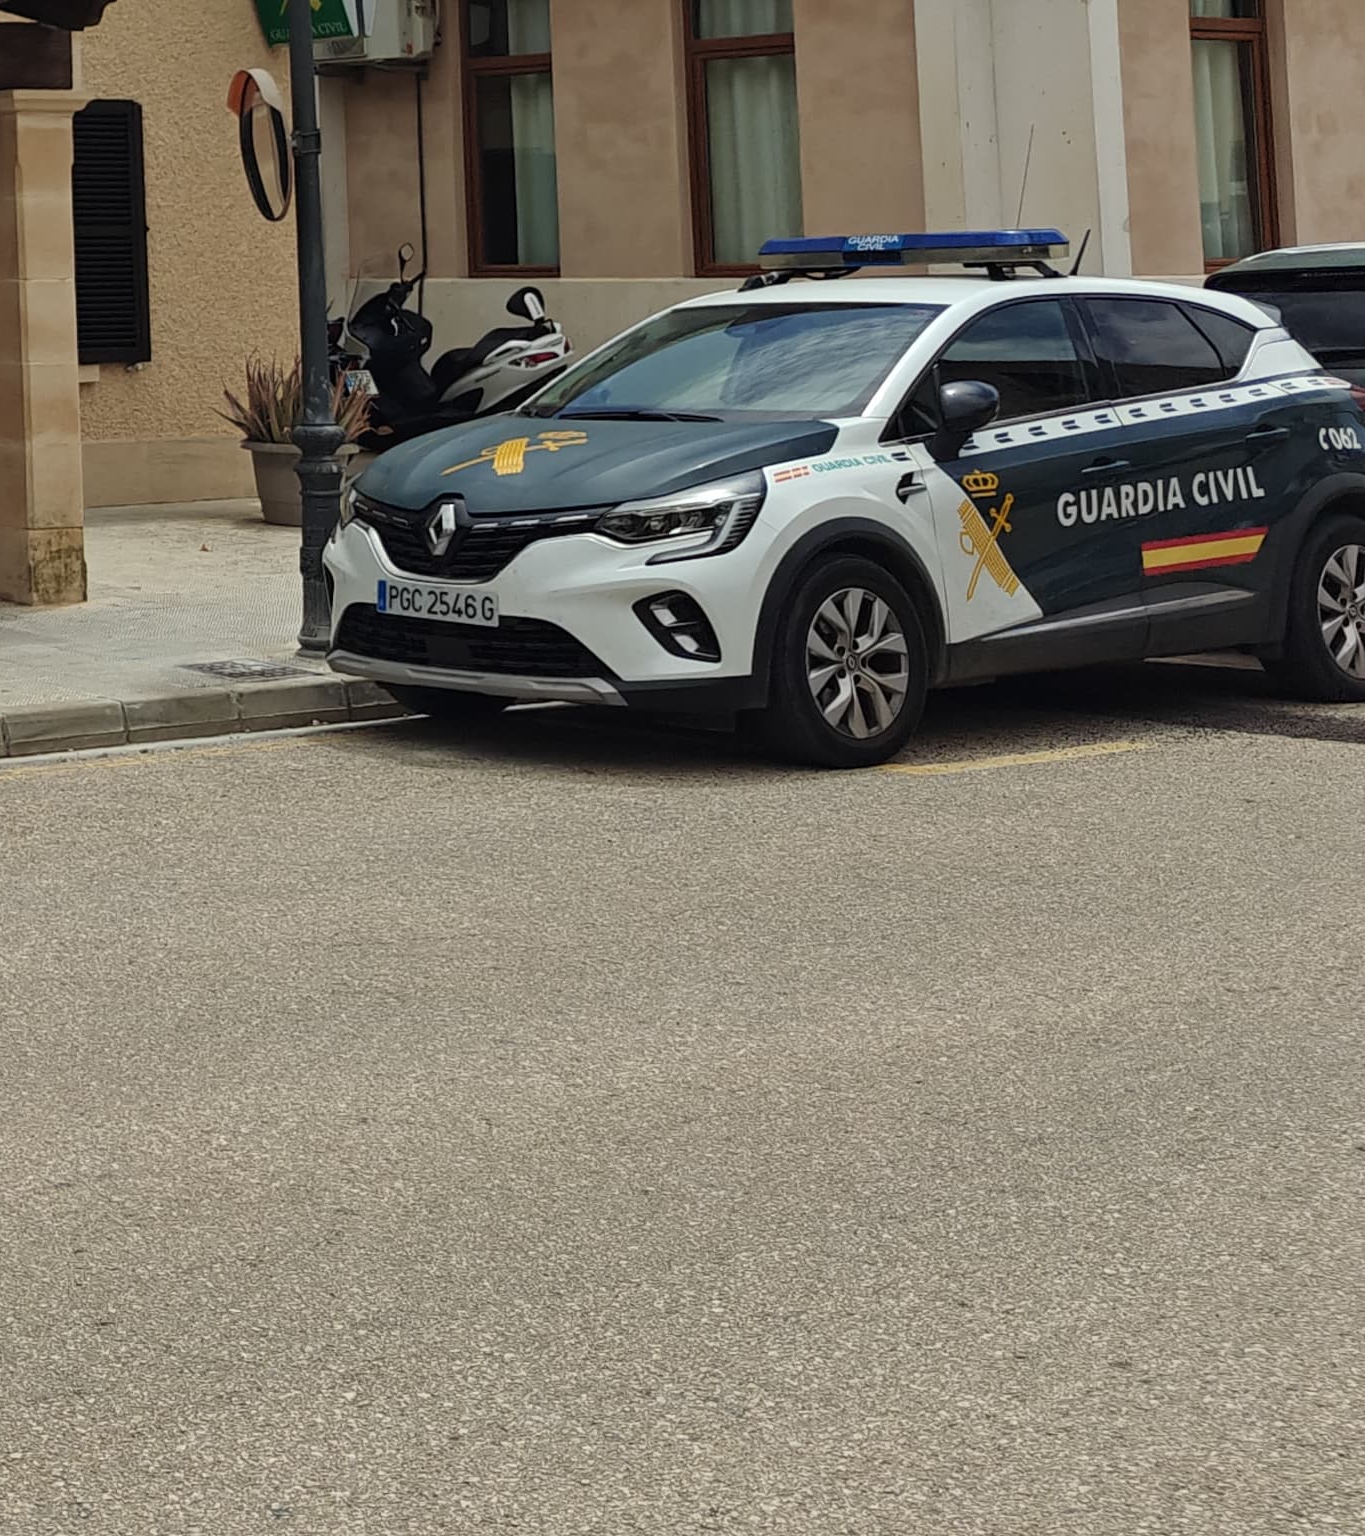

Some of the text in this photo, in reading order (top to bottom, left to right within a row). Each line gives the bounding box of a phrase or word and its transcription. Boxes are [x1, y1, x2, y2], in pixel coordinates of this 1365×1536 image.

[848, 235, 899, 245] GUARDIA
[857, 243, 886, 251] CIVIL
[1328, 427, 1362, 450] 062
[812, 454, 891, 472] GUARDIA CIVIL
[1057, 466, 1265, 527] GUARDIA CIVIL
[389, 585, 495, 621] PGC 2546 G
